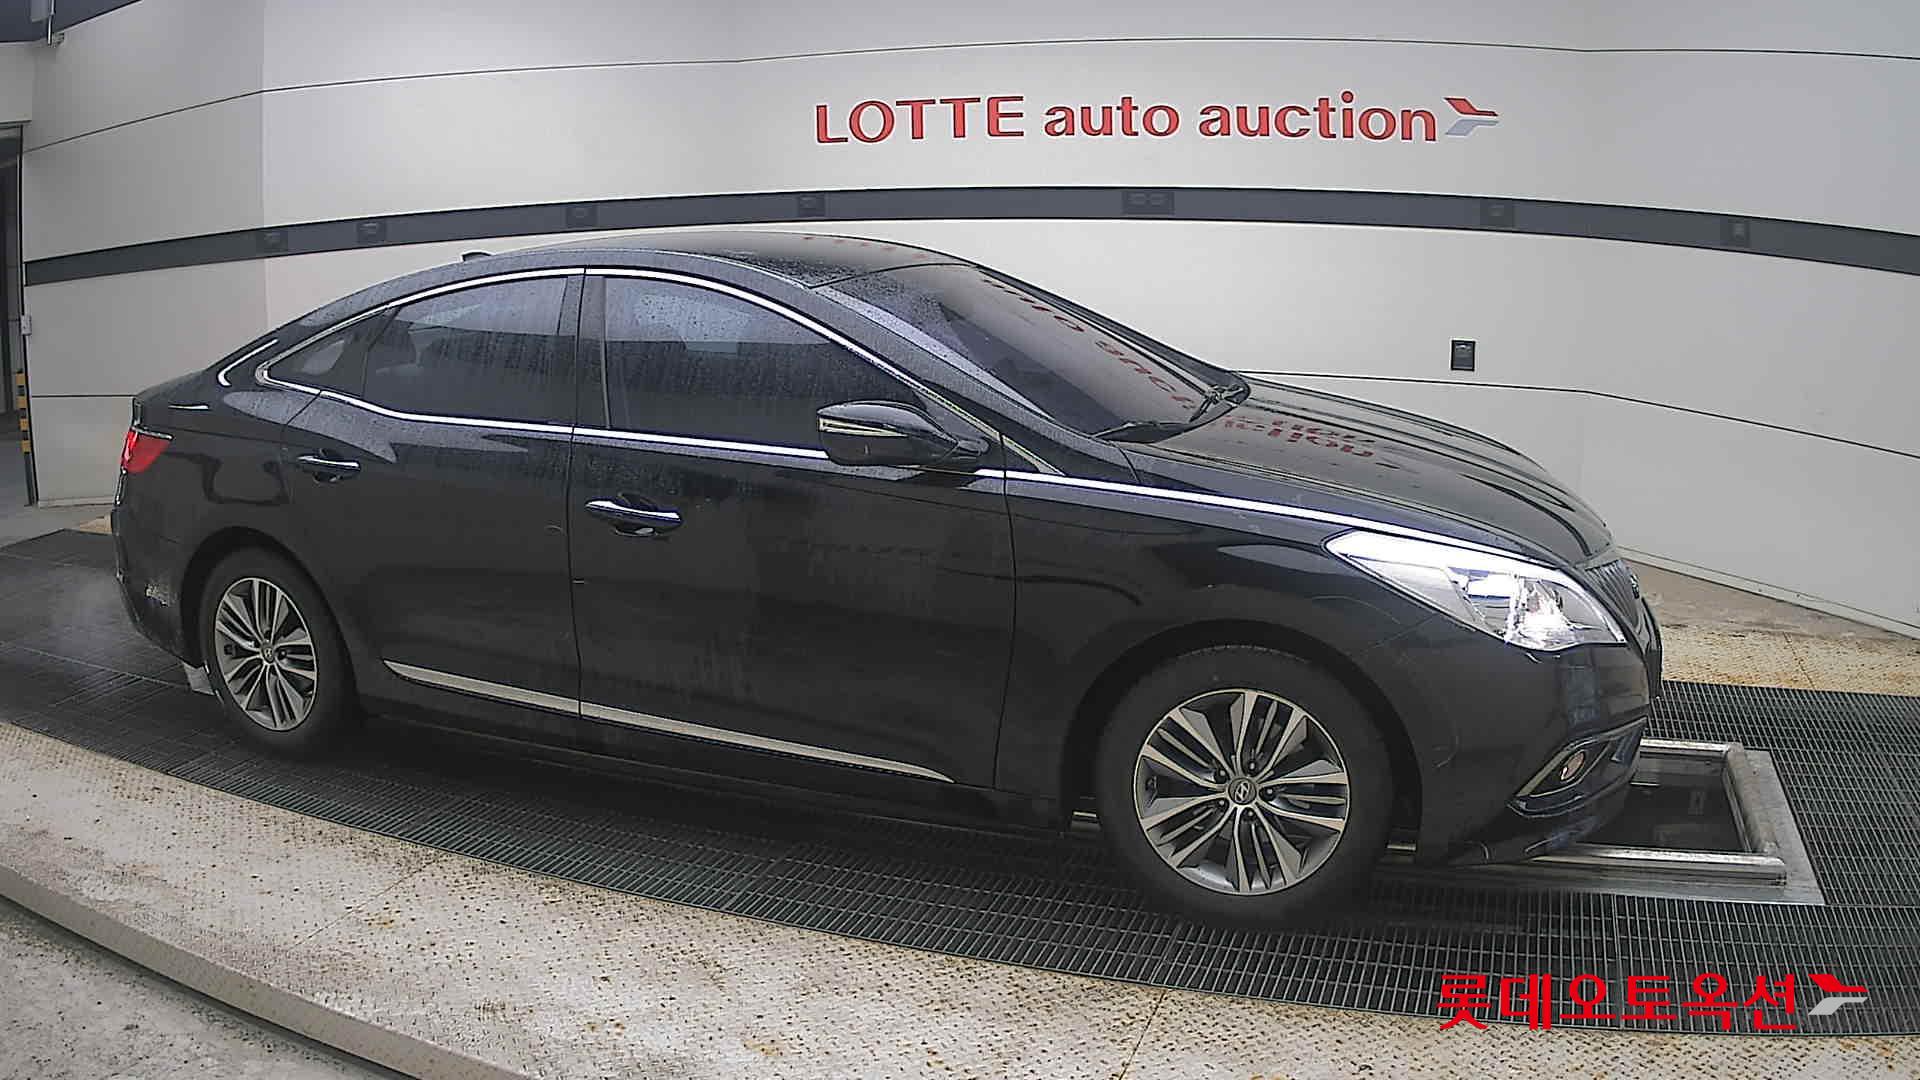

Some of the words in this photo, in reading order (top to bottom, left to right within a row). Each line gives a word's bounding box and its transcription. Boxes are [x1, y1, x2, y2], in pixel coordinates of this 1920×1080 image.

[815, 95, 1024, 144] LOTTE
[1043, 97, 1181, 137] auto
[1199, 91, 1438, 142] auction
